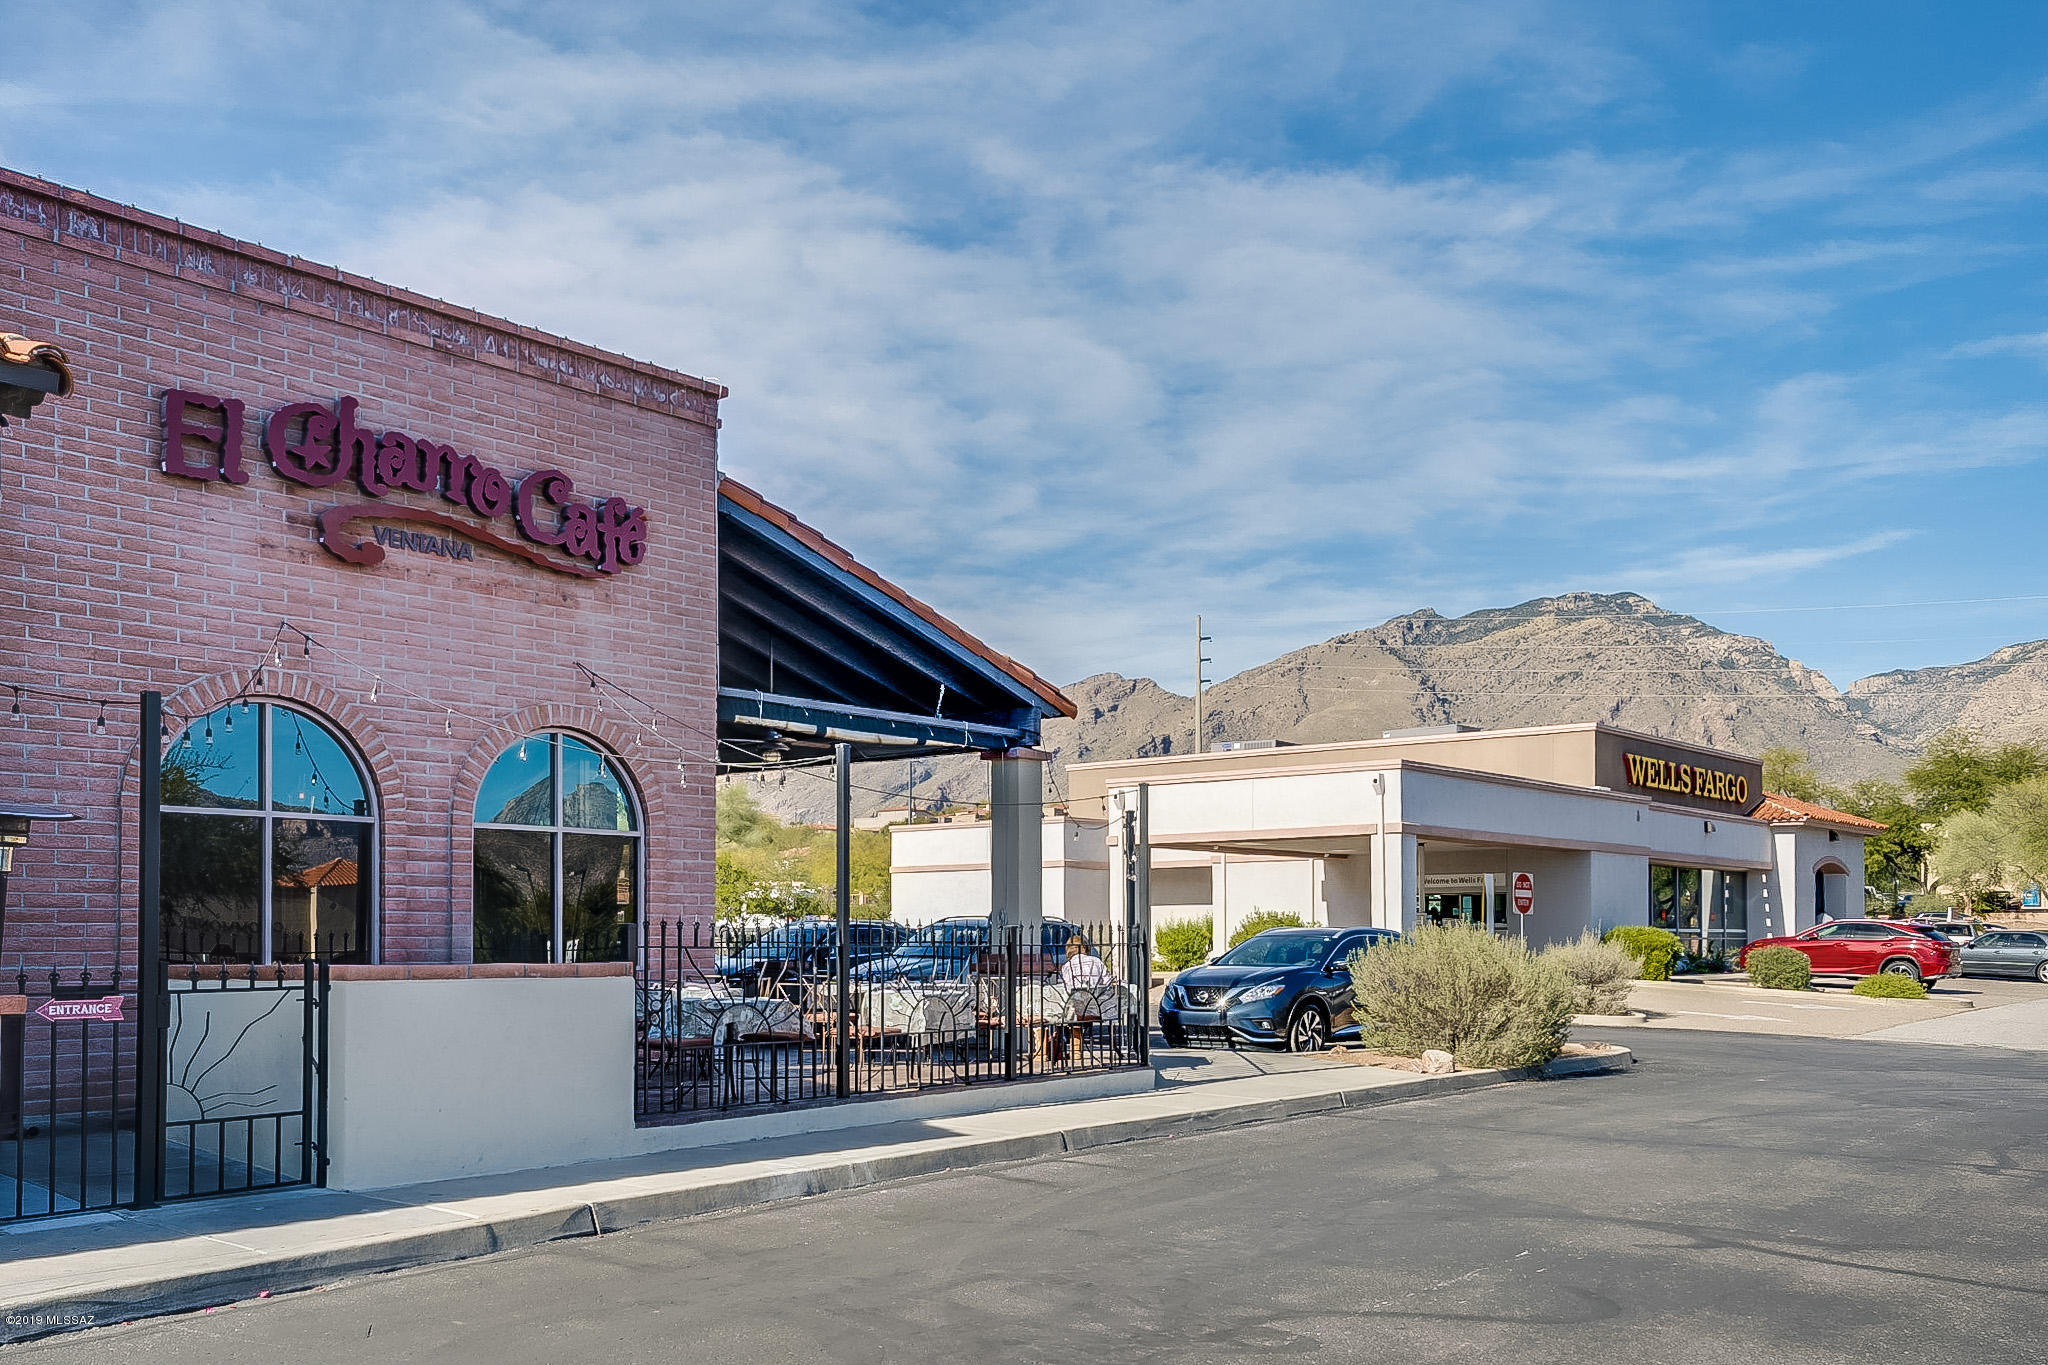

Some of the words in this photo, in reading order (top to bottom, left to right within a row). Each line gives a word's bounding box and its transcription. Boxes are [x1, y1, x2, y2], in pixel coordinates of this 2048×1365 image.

[162, 388, 249, 485] El
[265, 395, 512, 518] Charro
[513, 469, 648, 574] Café
[373, 525, 474, 562] VENTANA
[1625, 753, 1691, 794] WELLS
[1694, 767, 1748, 804] FARGO
[1459, 876, 1476, 884] Wells
[49, 1004, 112, 1015] ENTRANCE
